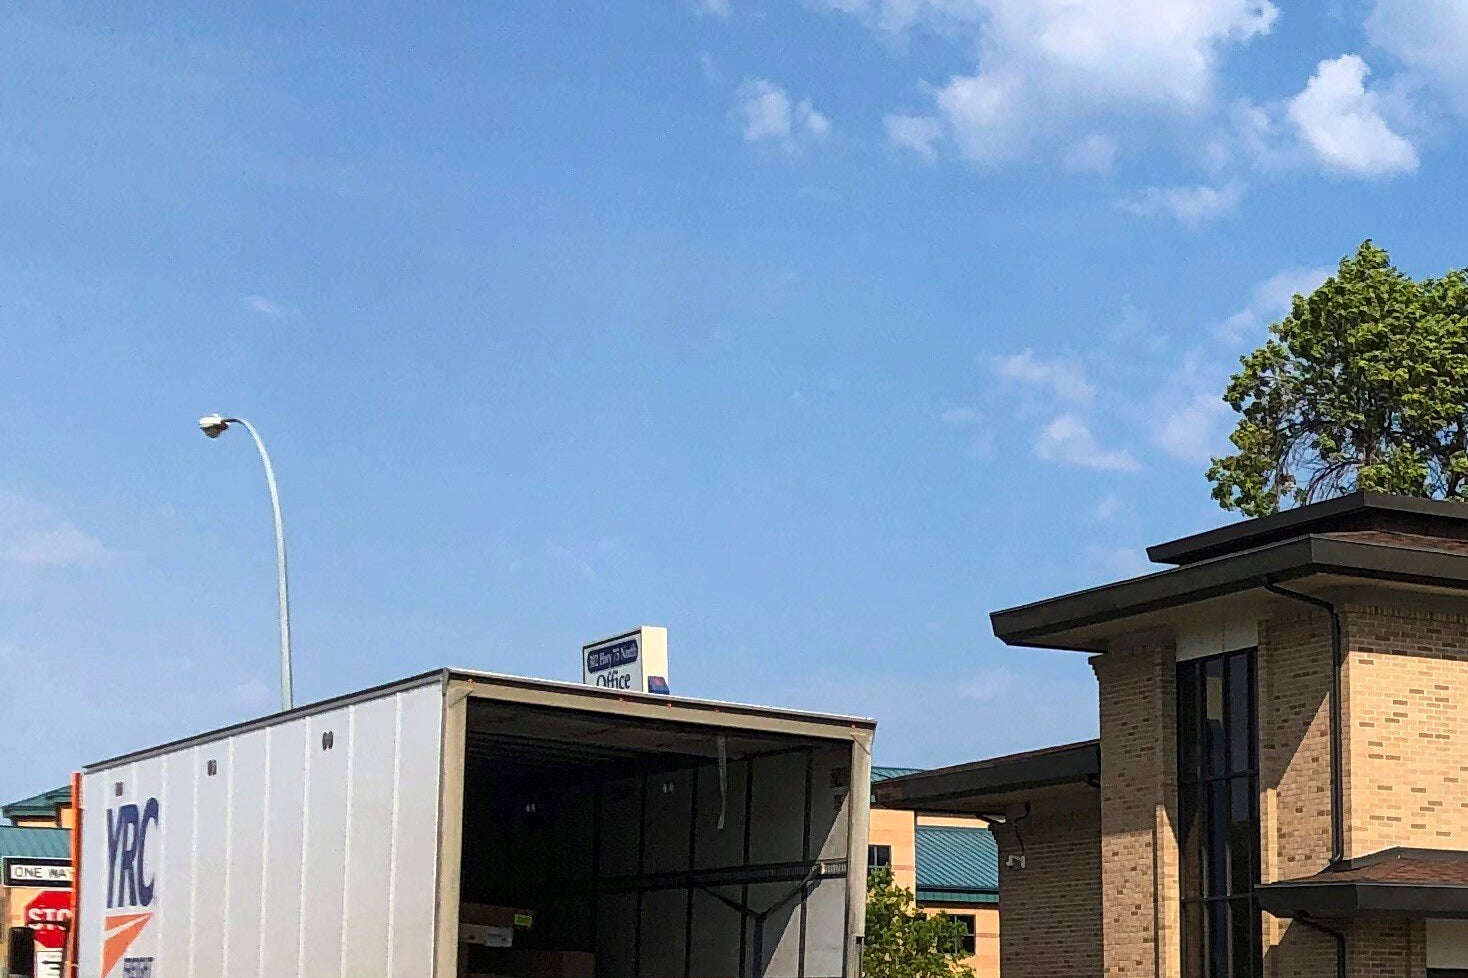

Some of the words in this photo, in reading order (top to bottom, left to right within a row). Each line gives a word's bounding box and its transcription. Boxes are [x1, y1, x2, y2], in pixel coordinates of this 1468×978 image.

[597, 670, 631, 689] Office
[106, 797, 159, 909] YRC
[14, 866, 42, 878] ONE
[28, 908, 72, 930] STO
